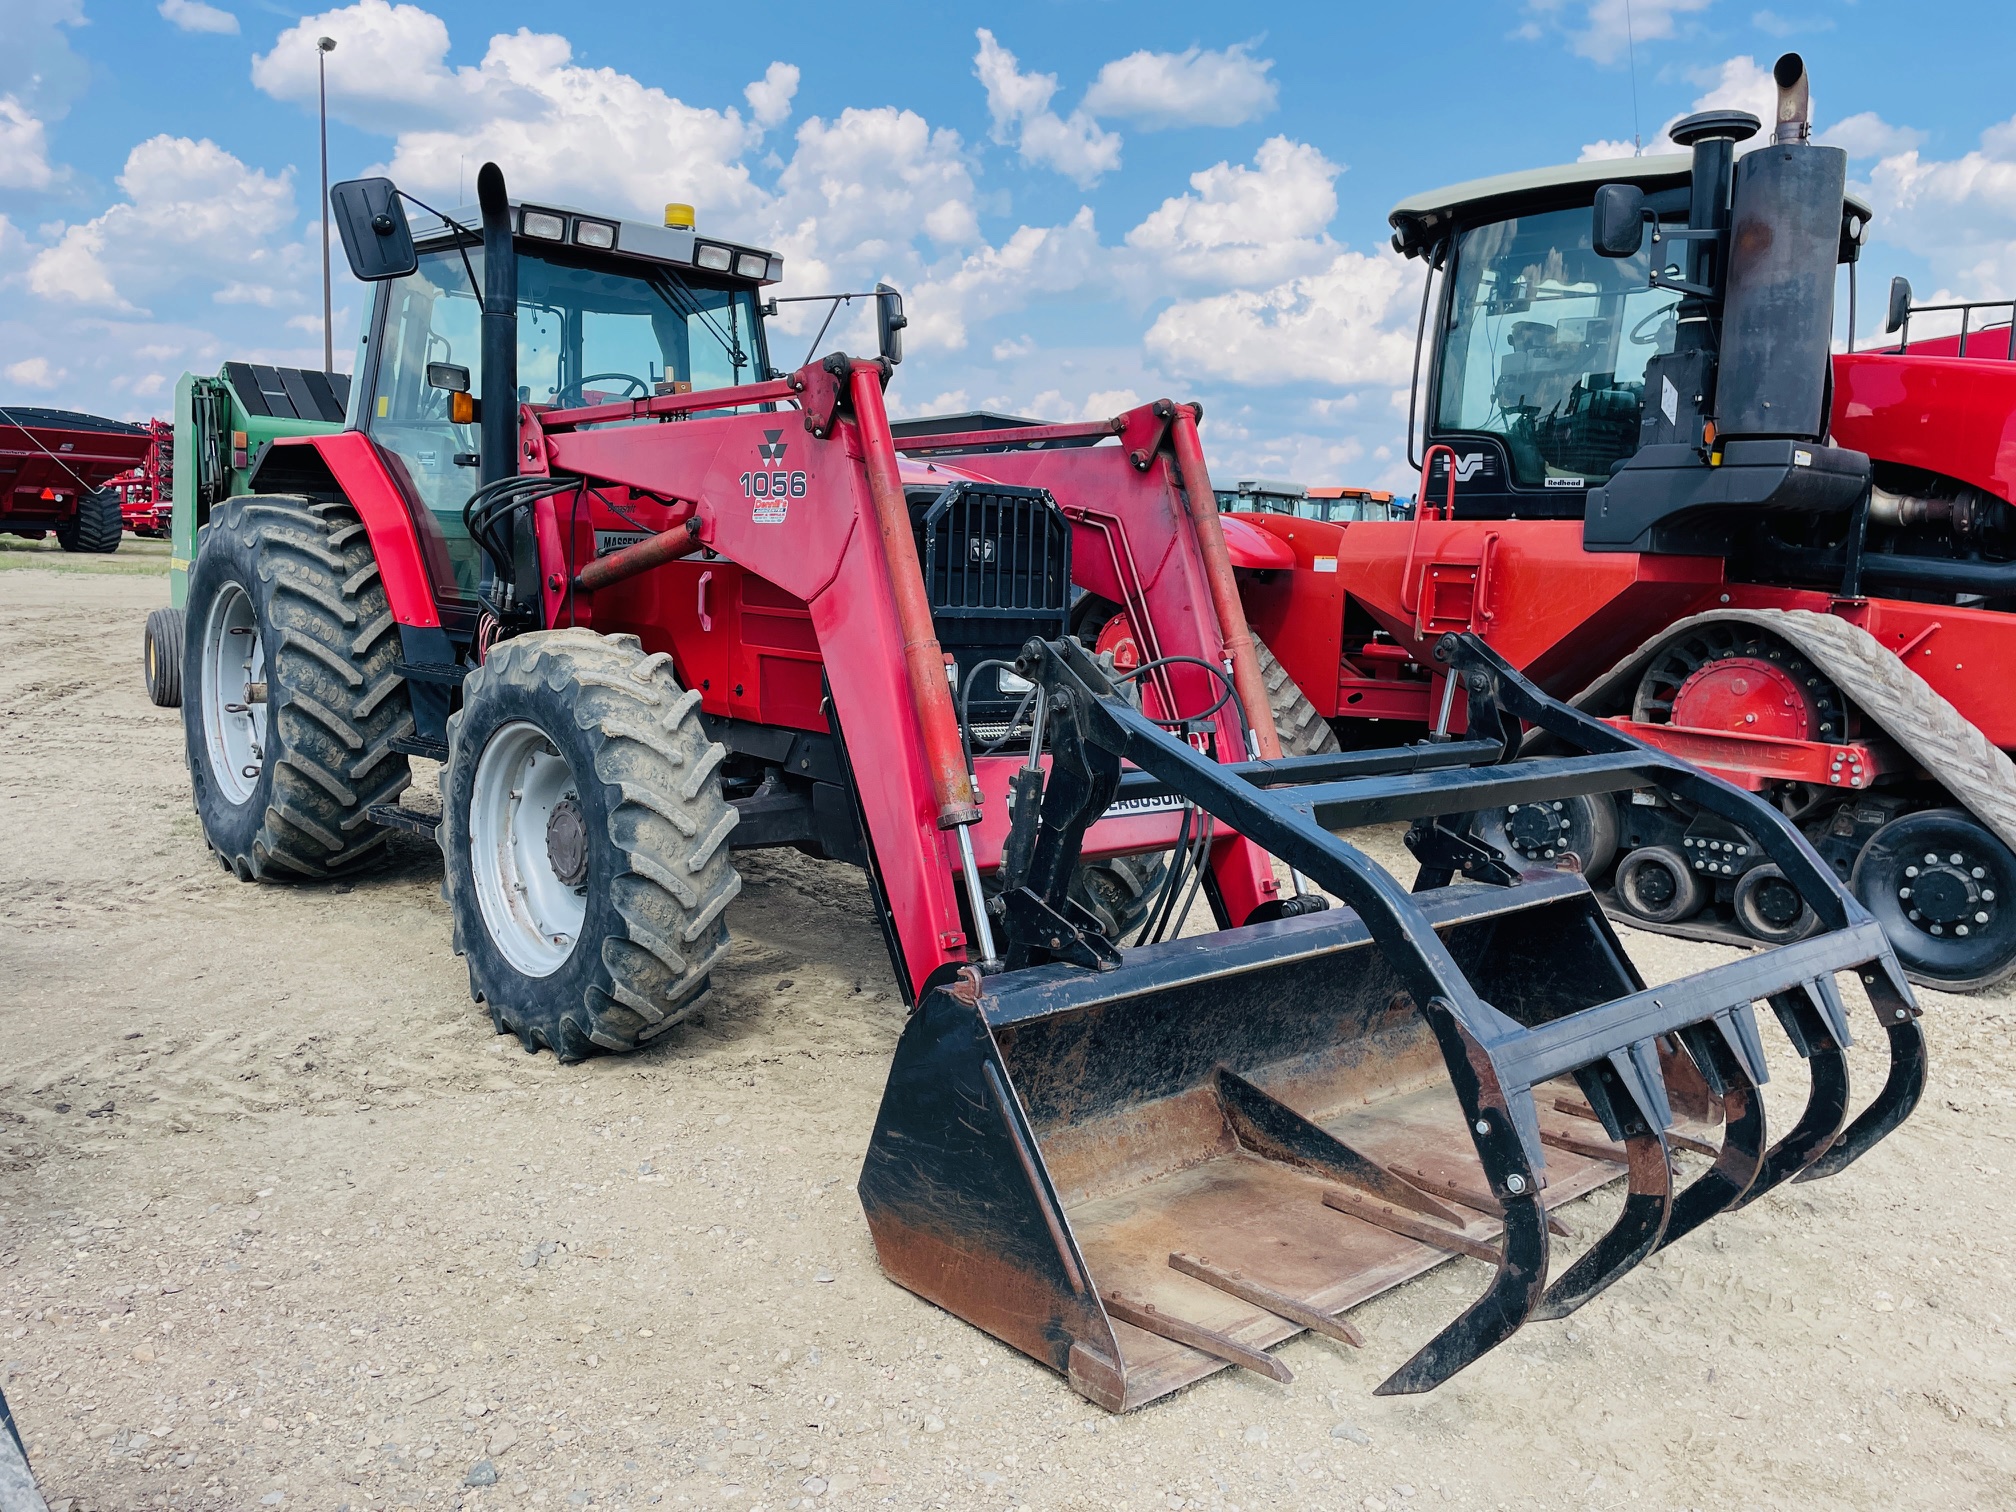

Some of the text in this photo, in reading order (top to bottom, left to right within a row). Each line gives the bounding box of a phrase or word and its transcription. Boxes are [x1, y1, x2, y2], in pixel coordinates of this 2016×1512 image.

[739, 471, 807, 498] 1056
[603, 536, 638, 548] MASSEY
[1108, 794, 1184, 811] ERGUSON
